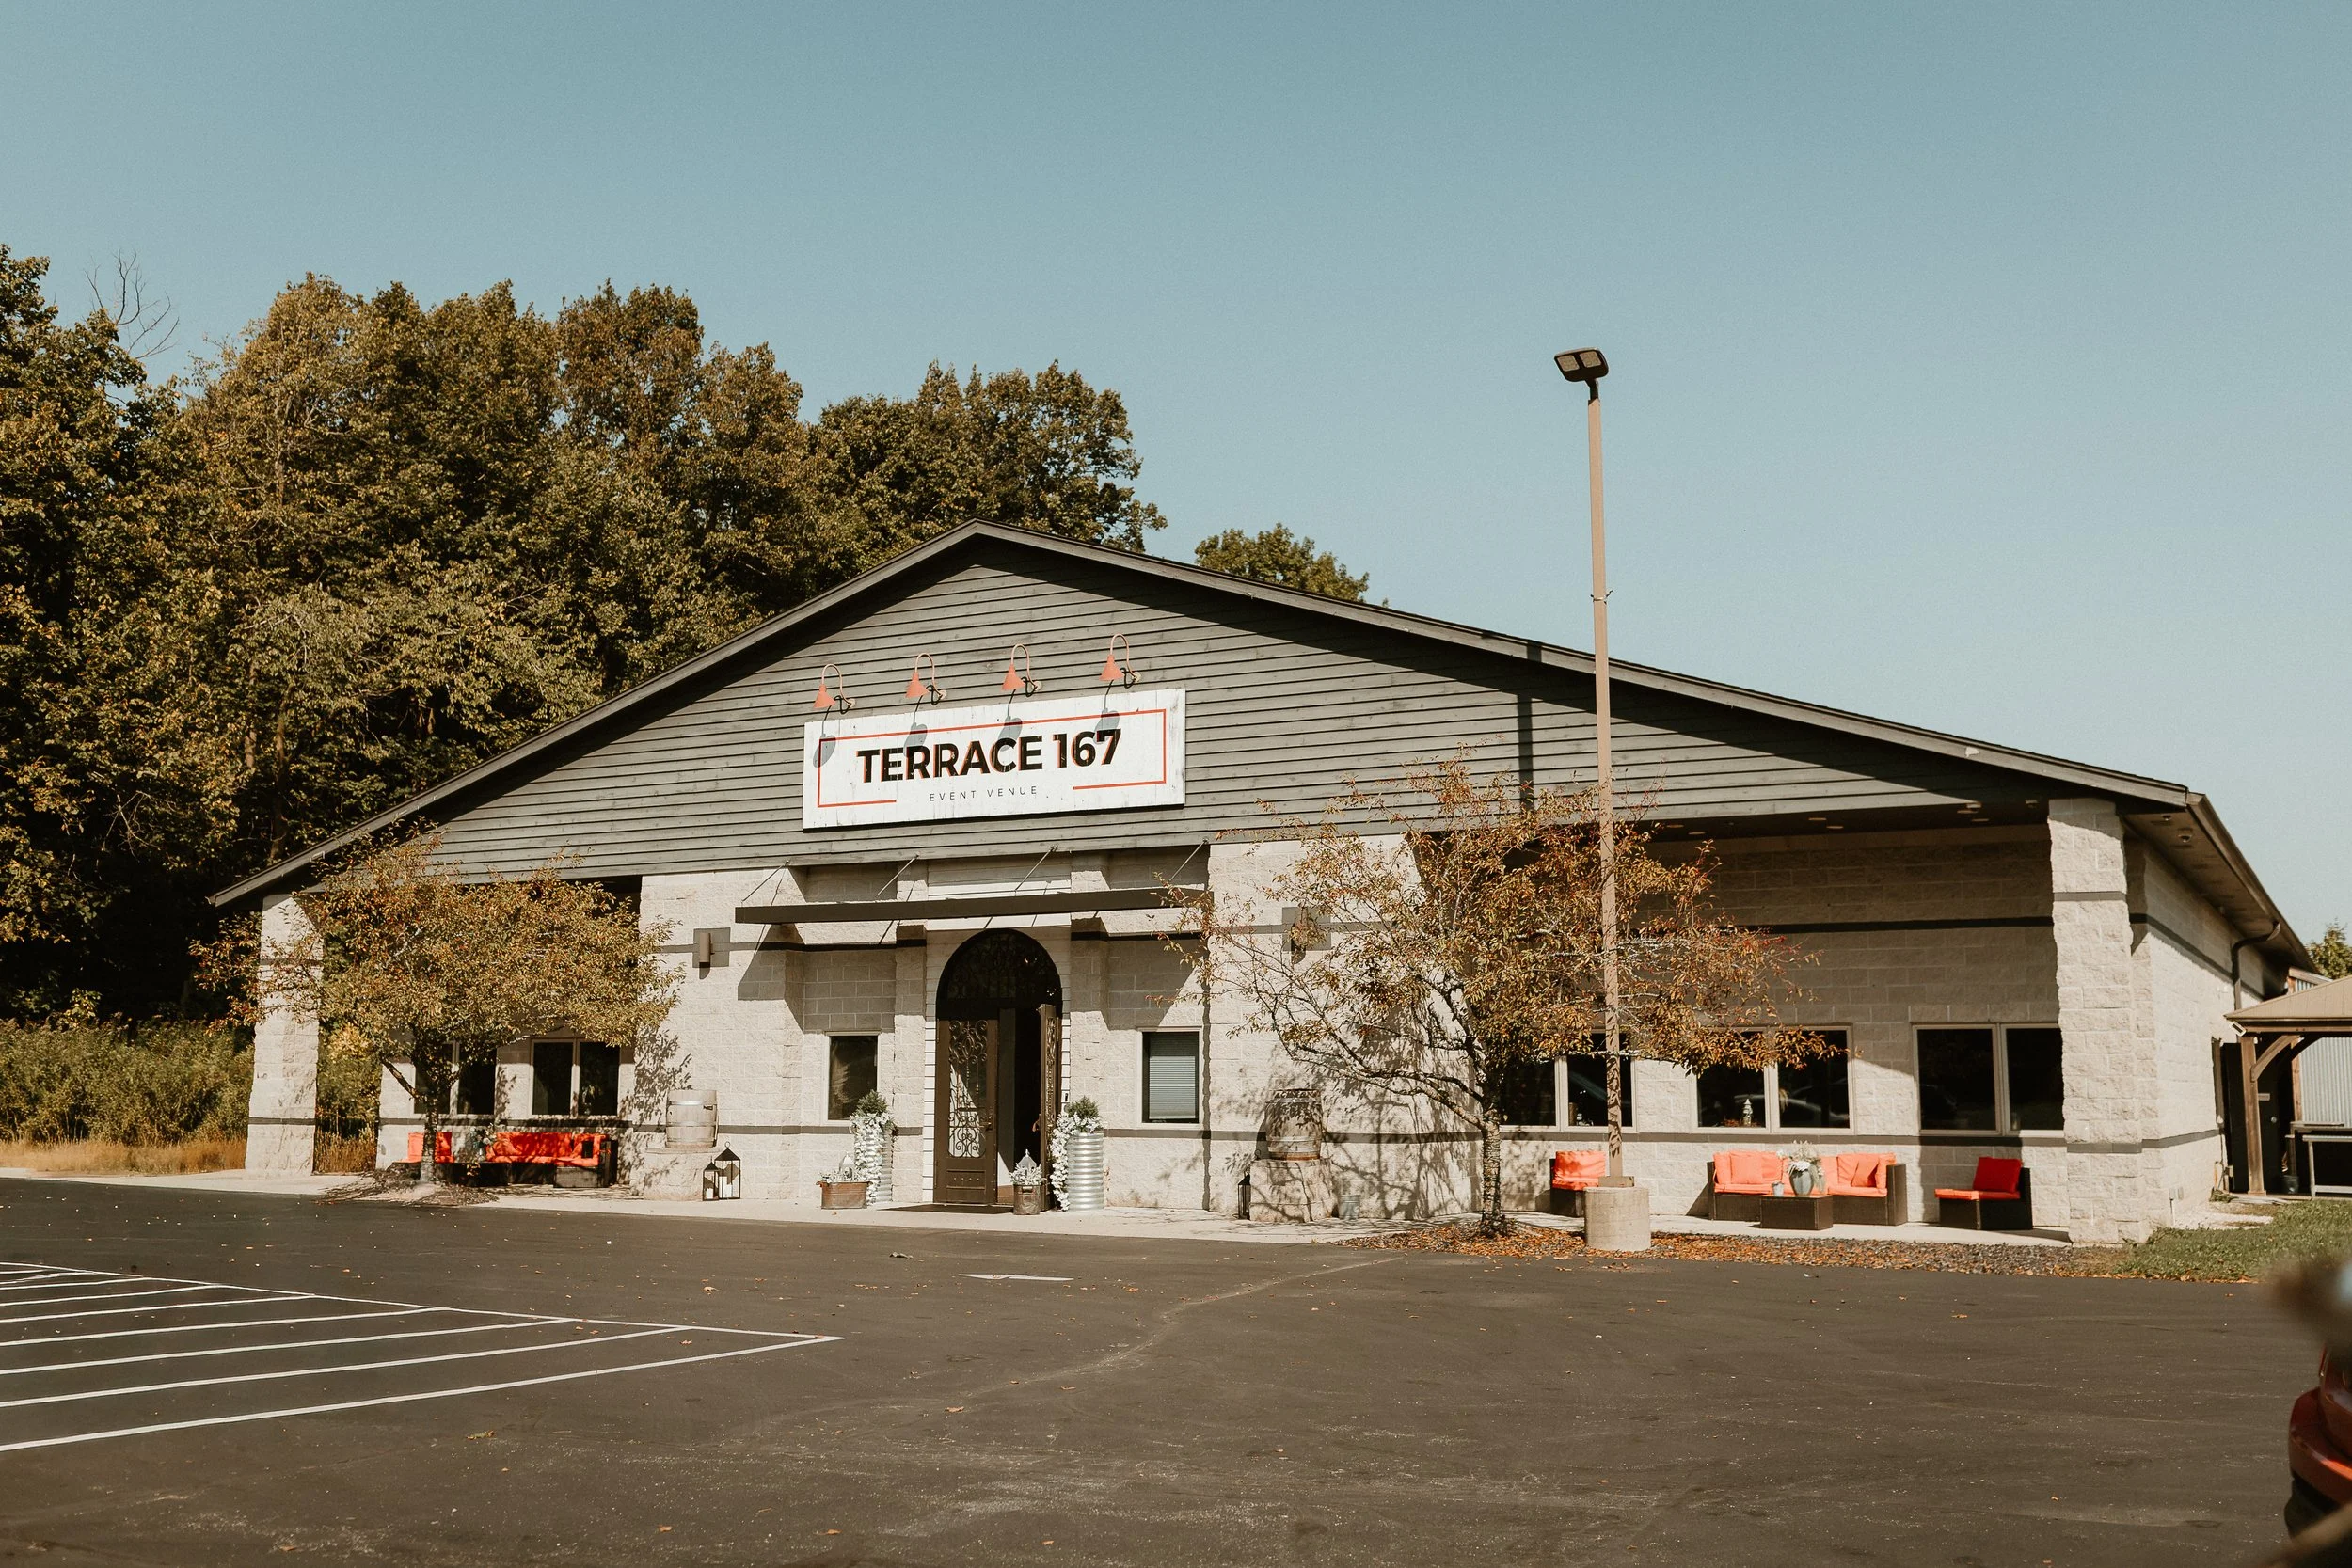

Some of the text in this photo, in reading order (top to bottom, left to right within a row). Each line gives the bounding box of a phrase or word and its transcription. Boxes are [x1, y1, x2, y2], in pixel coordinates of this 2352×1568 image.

[856, 728, 1122, 783] TERRACE 167
[929, 785, 1038, 802] EVENT VENUE
